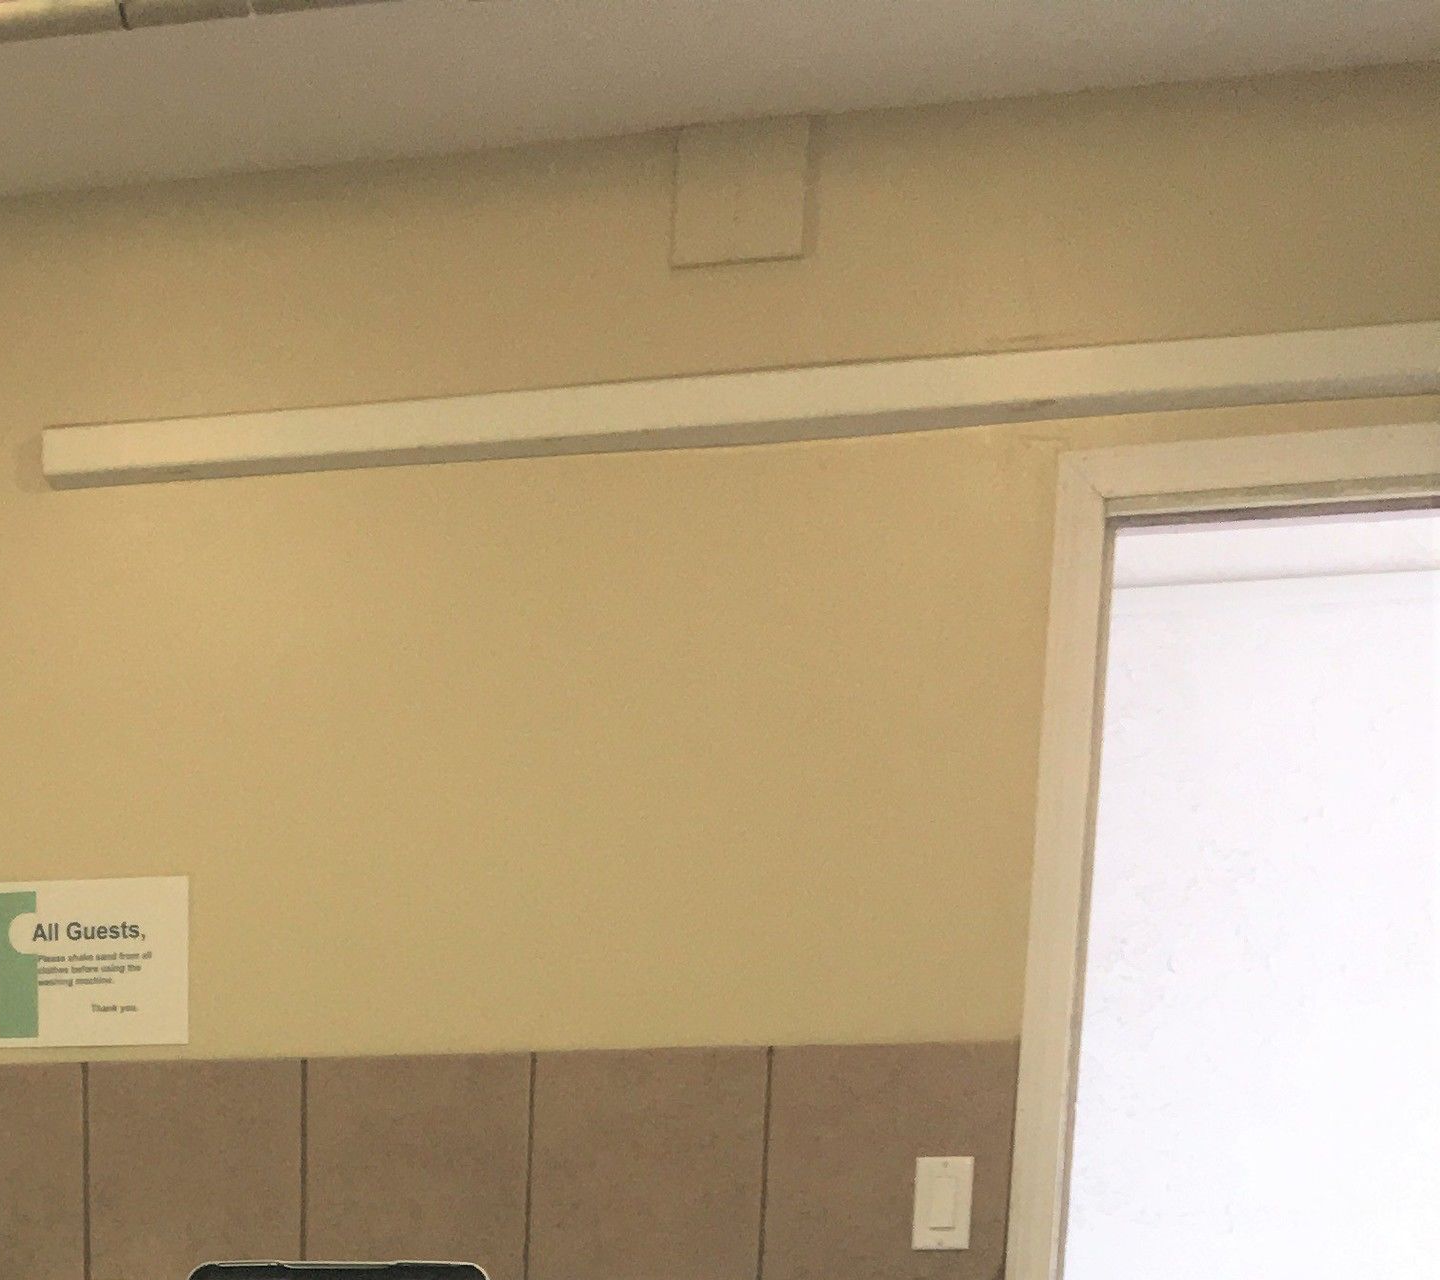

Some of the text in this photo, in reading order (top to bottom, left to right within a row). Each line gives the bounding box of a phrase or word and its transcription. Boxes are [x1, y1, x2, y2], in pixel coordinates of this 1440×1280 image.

[32, 921, 146, 942] All Guests,
[95, 952, 117, 961] sand
[70, 965, 99, 974] before
[101, 964, 125, 974] using
[127, 964, 142, 972] the
[91, 1003, 118, 1013] Thank
